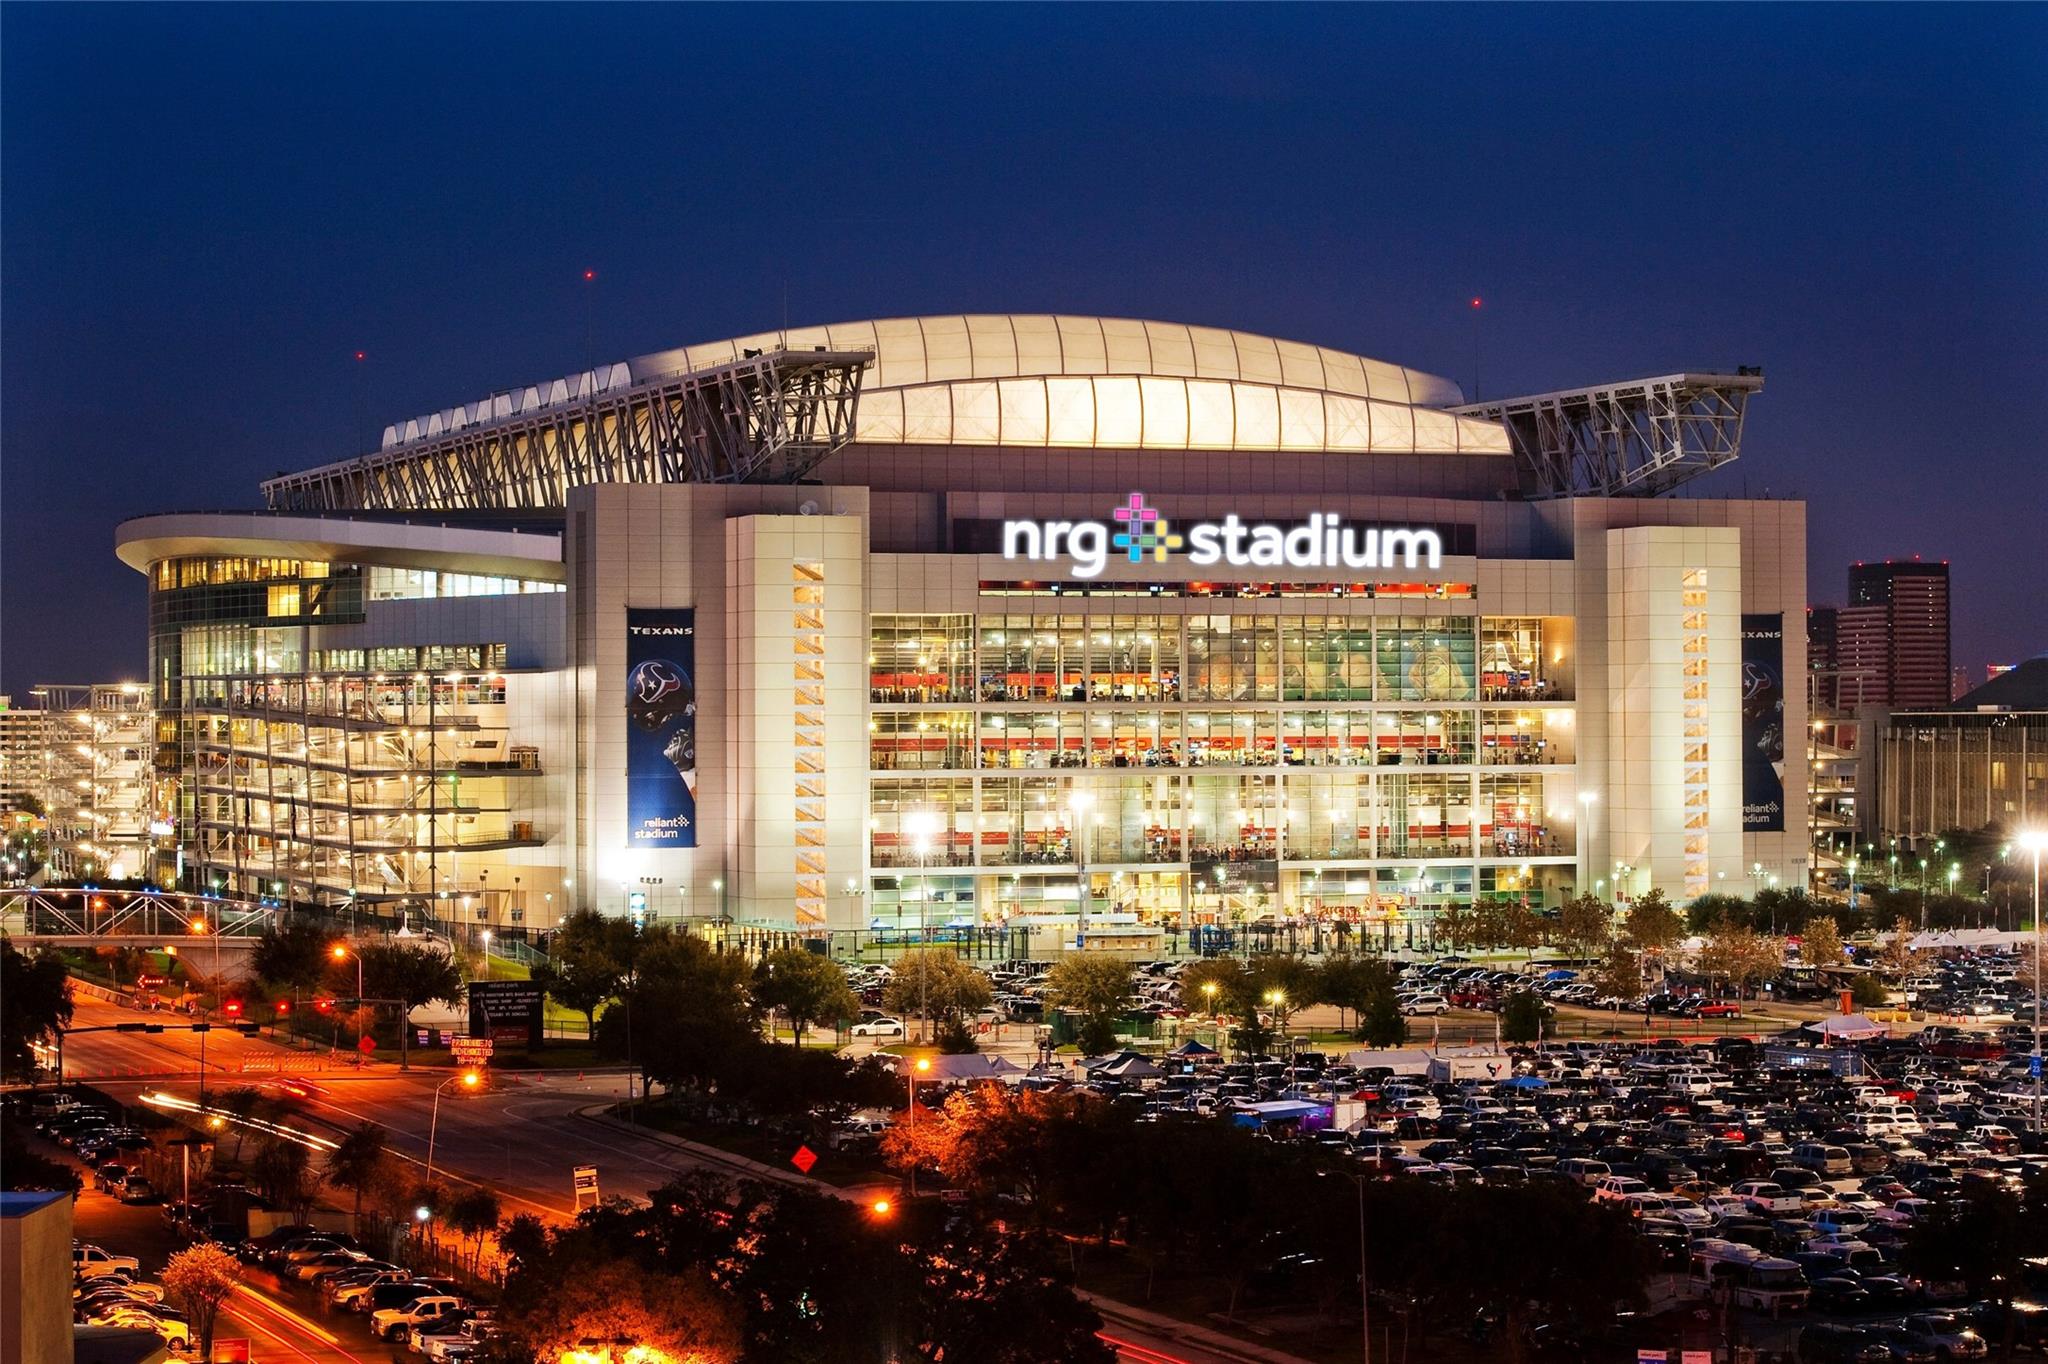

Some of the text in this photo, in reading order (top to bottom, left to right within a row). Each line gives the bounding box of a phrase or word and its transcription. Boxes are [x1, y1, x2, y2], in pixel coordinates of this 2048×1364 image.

[1003, 512, 1442, 578] nrg stadium
[630, 626, 693, 635] TEXANS
[1741, 631, 1781, 639] EXANS
[1743, 803, 1770, 813] reliant
[644, 817, 678, 828] reliant
[1743, 813, 1770, 823] adium
[634, 828, 678, 839] stadium
